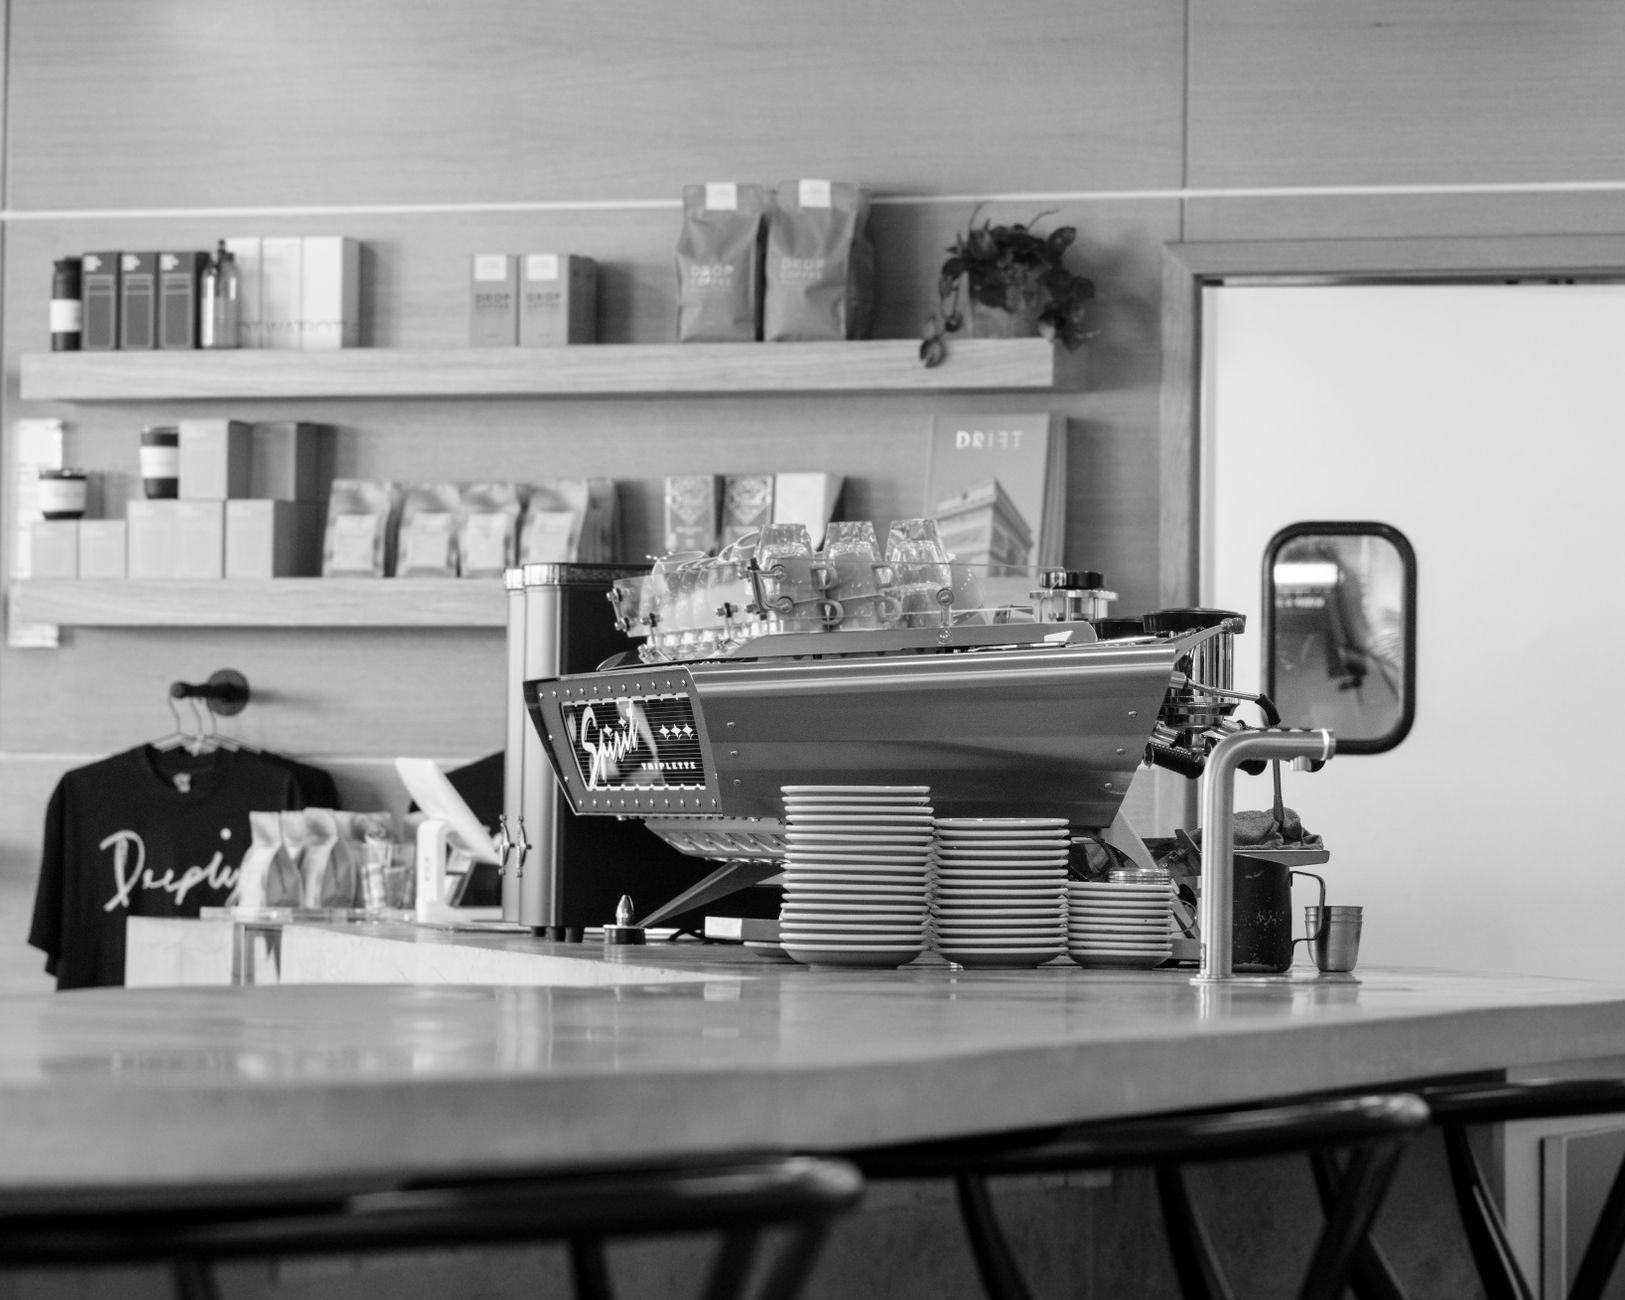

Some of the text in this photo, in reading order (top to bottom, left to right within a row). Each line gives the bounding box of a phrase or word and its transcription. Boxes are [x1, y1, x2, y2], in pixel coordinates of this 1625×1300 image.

[780, 257, 825, 270] DROP
[690, 264, 734, 276] DROP
[956, 429, 1023, 450] DRIFT
[641, 761, 697, 771] TRIPLETTE
